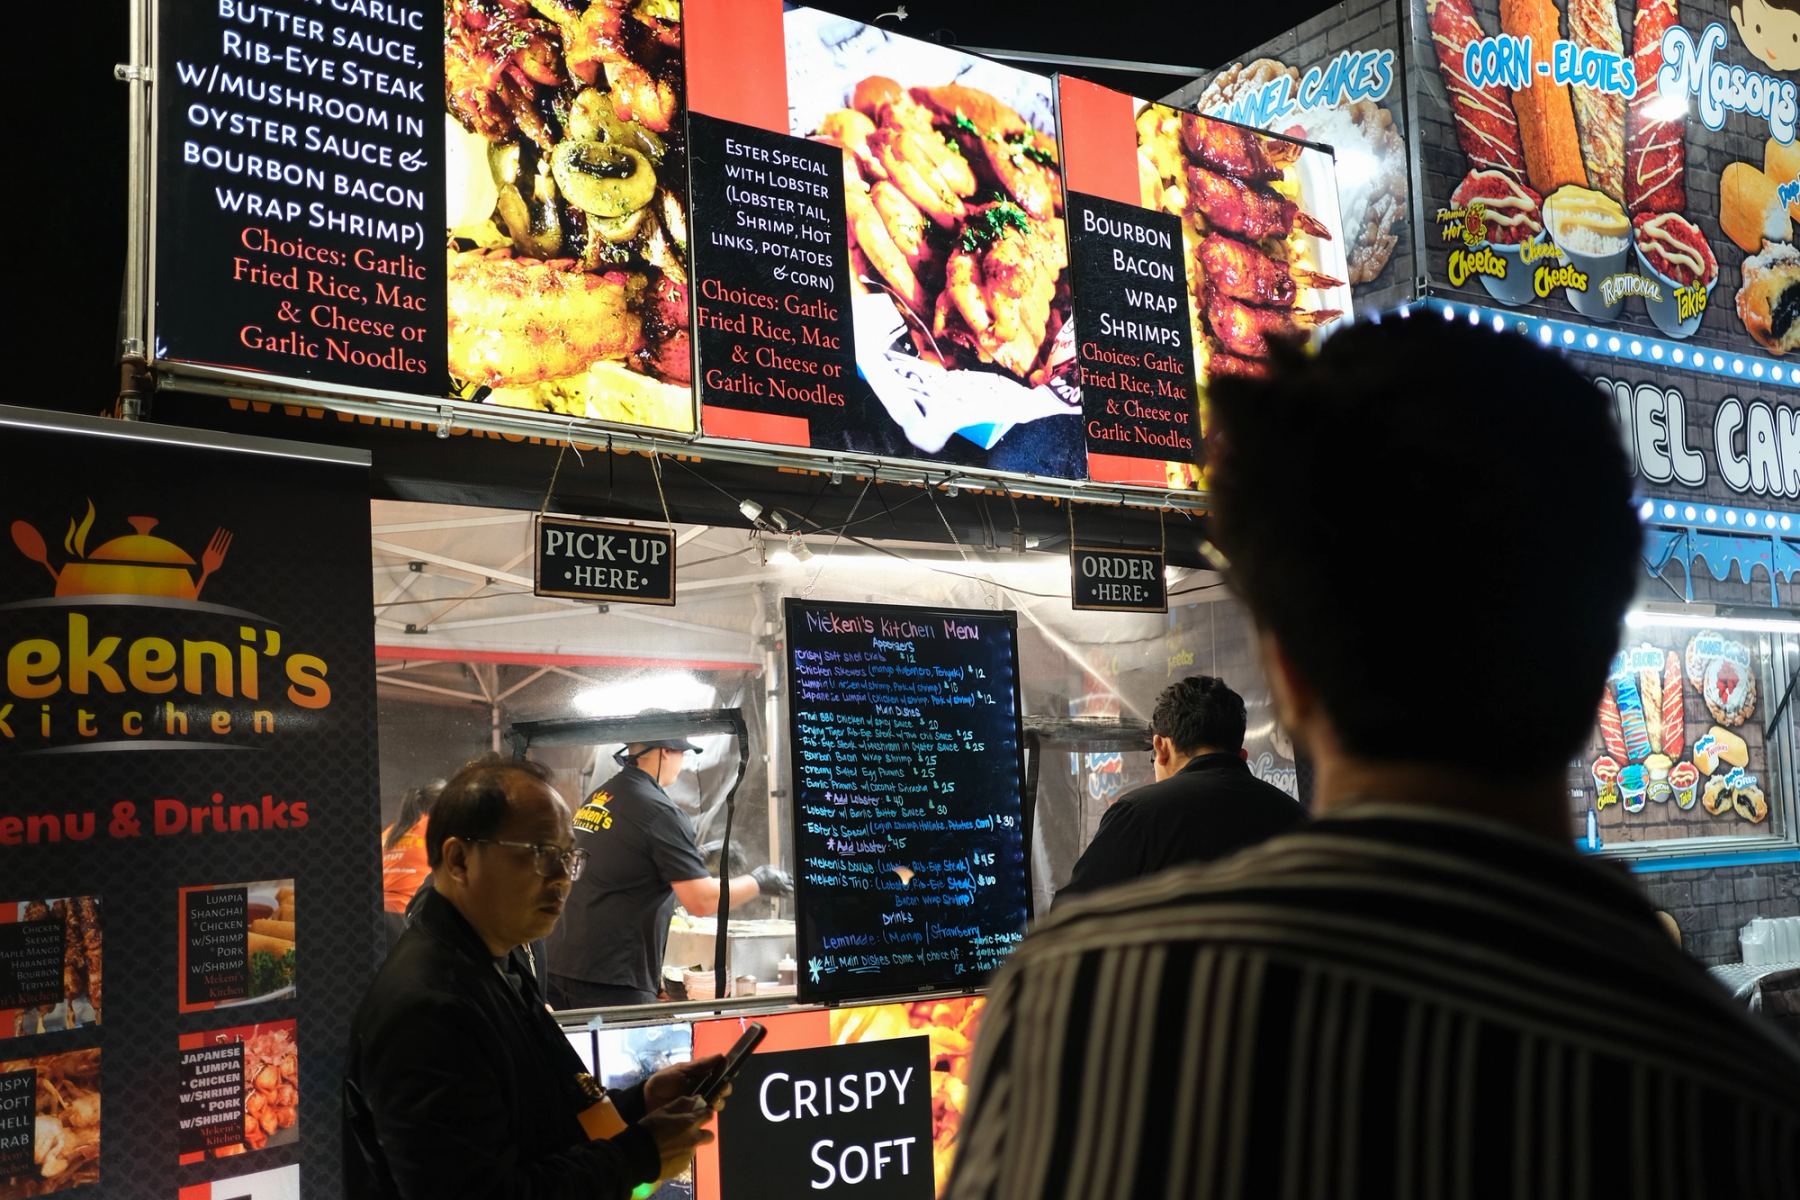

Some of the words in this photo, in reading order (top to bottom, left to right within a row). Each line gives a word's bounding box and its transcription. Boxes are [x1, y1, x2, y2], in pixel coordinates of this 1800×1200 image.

[219, 0, 322, 42] BUTTER
[333, 27, 423, 68] SAUCE,
[223, 30, 335, 80] RIB-EYE
[342, 61, 424, 102] STEAK
[1465, 36, 1530, 88] CORN
[1554, 42, 1636, 94] ELOTES
[177, 62, 388, 130] W/MUSHROOM
[397, 114, 423, 138] IN
[1213, 76, 1296, 128] NNEL
[1298, 51, 1394, 110] CAKES
[1658, 24, 1797, 144] Masons
[188, 105, 297, 146] OYSTER
[305, 127, 392, 167] SAUCE
[399, 149, 427, 171] &
[726, 139, 769, 162] ESTER
[772, 150, 828, 176] SPECIAL
[184, 142, 324, 190] BOURBON
[334, 175, 423, 210] BACON
[726, 164, 764, 184] WITH
[769, 172, 828, 199] LOBSTER
[216, 188, 301, 221] WRAP
[309, 202, 423, 250] SHRIMP)
[726, 185, 794, 212] (LOBSTER
[798, 204, 830, 222] TAIL,
[737, 211, 798, 239] SHRIMP,
[802, 225, 831, 244] HOT
[1084, 210, 1171, 250] BOURBON
[1442, 224, 1463, 240] Hot
[241, 228, 346, 266] Choices:
[354, 249, 426, 280] Garlic
[712, 232, 758, 254] LINKS,
[762, 242, 832, 267] POTATOES
[1113, 249, 1174, 282] BACON
[1449, 246, 1507, 287] Cheetos
[233, 257, 298, 289] Fried
[308, 271, 367, 305] Rice,
[376, 283, 426, 311] Mac
[1534, 264, 1588, 297] Cheetos
[1600, 276, 1663, 306] TRADITIONAL
[702, 280, 778, 311] Choices:
[784, 296, 838, 320] Garlic
[1125, 288, 1177, 314] WRAP
[1674, 280, 1707, 324] Takis
[278, 301, 300, 323] &
[311, 304, 394, 338] Cheese
[402, 325, 426, 343] or
[698, 307, 746, 334] Fried
[752, 316, 796, 344] Rice,
[802, 327, 840, 349] Mac
[1101, 313, 1180, 347] SHRIMPS
[240, 326, 318, 358] Garlic
[326, 338, 427, 374] Noodles
[732, 346, 748, 363] &
[756, 347, 818, 374] Cheese
[823, 364, 841, 378] or
[1082, 343, 1140, 367] Choices:
[1144, 353, 1184, 375] Garlic
[706, 369, 763, 396] Garlic
[769, 378, 844, 406] Noodles
[1081, 367, 1116, 389] Fried
[1120, 376, 1154, 397] Rice,
[1159, 380, 1186, 399] Mac
[1107, 399, 1120, 414] &
[1124, 400, 1170, 422] Cheese
[1175, 411, 1188, 424] or
[1088, 422, 1130, 441] Garlic
[1135, 427, 1192, 449] Noodles
[1714, 397, 1800, 498] CAK
[546, 530, 667, 565] PICK-UP
[1082, 556, 1155, 580] ORDER
[944, 619, 979, 640] Menu
[7, 612, 332, 710] ekeni's
[0, 811, 96, 845] enu
[108, 801, 142, 838] &
[154, 792, 309, 836] Drinks
[191, 907, 243, 919] SHANGHAI
[206, 894, 243, 905] LUMPIA
[200, 920, 243, 932] CHICKEN
[882, 910, 913, 925] Drinks
[217, 947, 243, 957] PORK
[181, 1048, 240, 1065] JAPANESE
[195, 1060, 240, 1075] LUMPIA
[0, 1077, 31, 1092] ISPY
[190, 1073, 240, 1089] CHICKEN
[759, 1066, 914, 1122] CRISPY
[209, 1098, 241, 1112] PORK
[0, 1116, 30, 1130] HELL
[0, 1134, 29, 1149] RAB
[810, 1136, 916, 1190] SOFT
